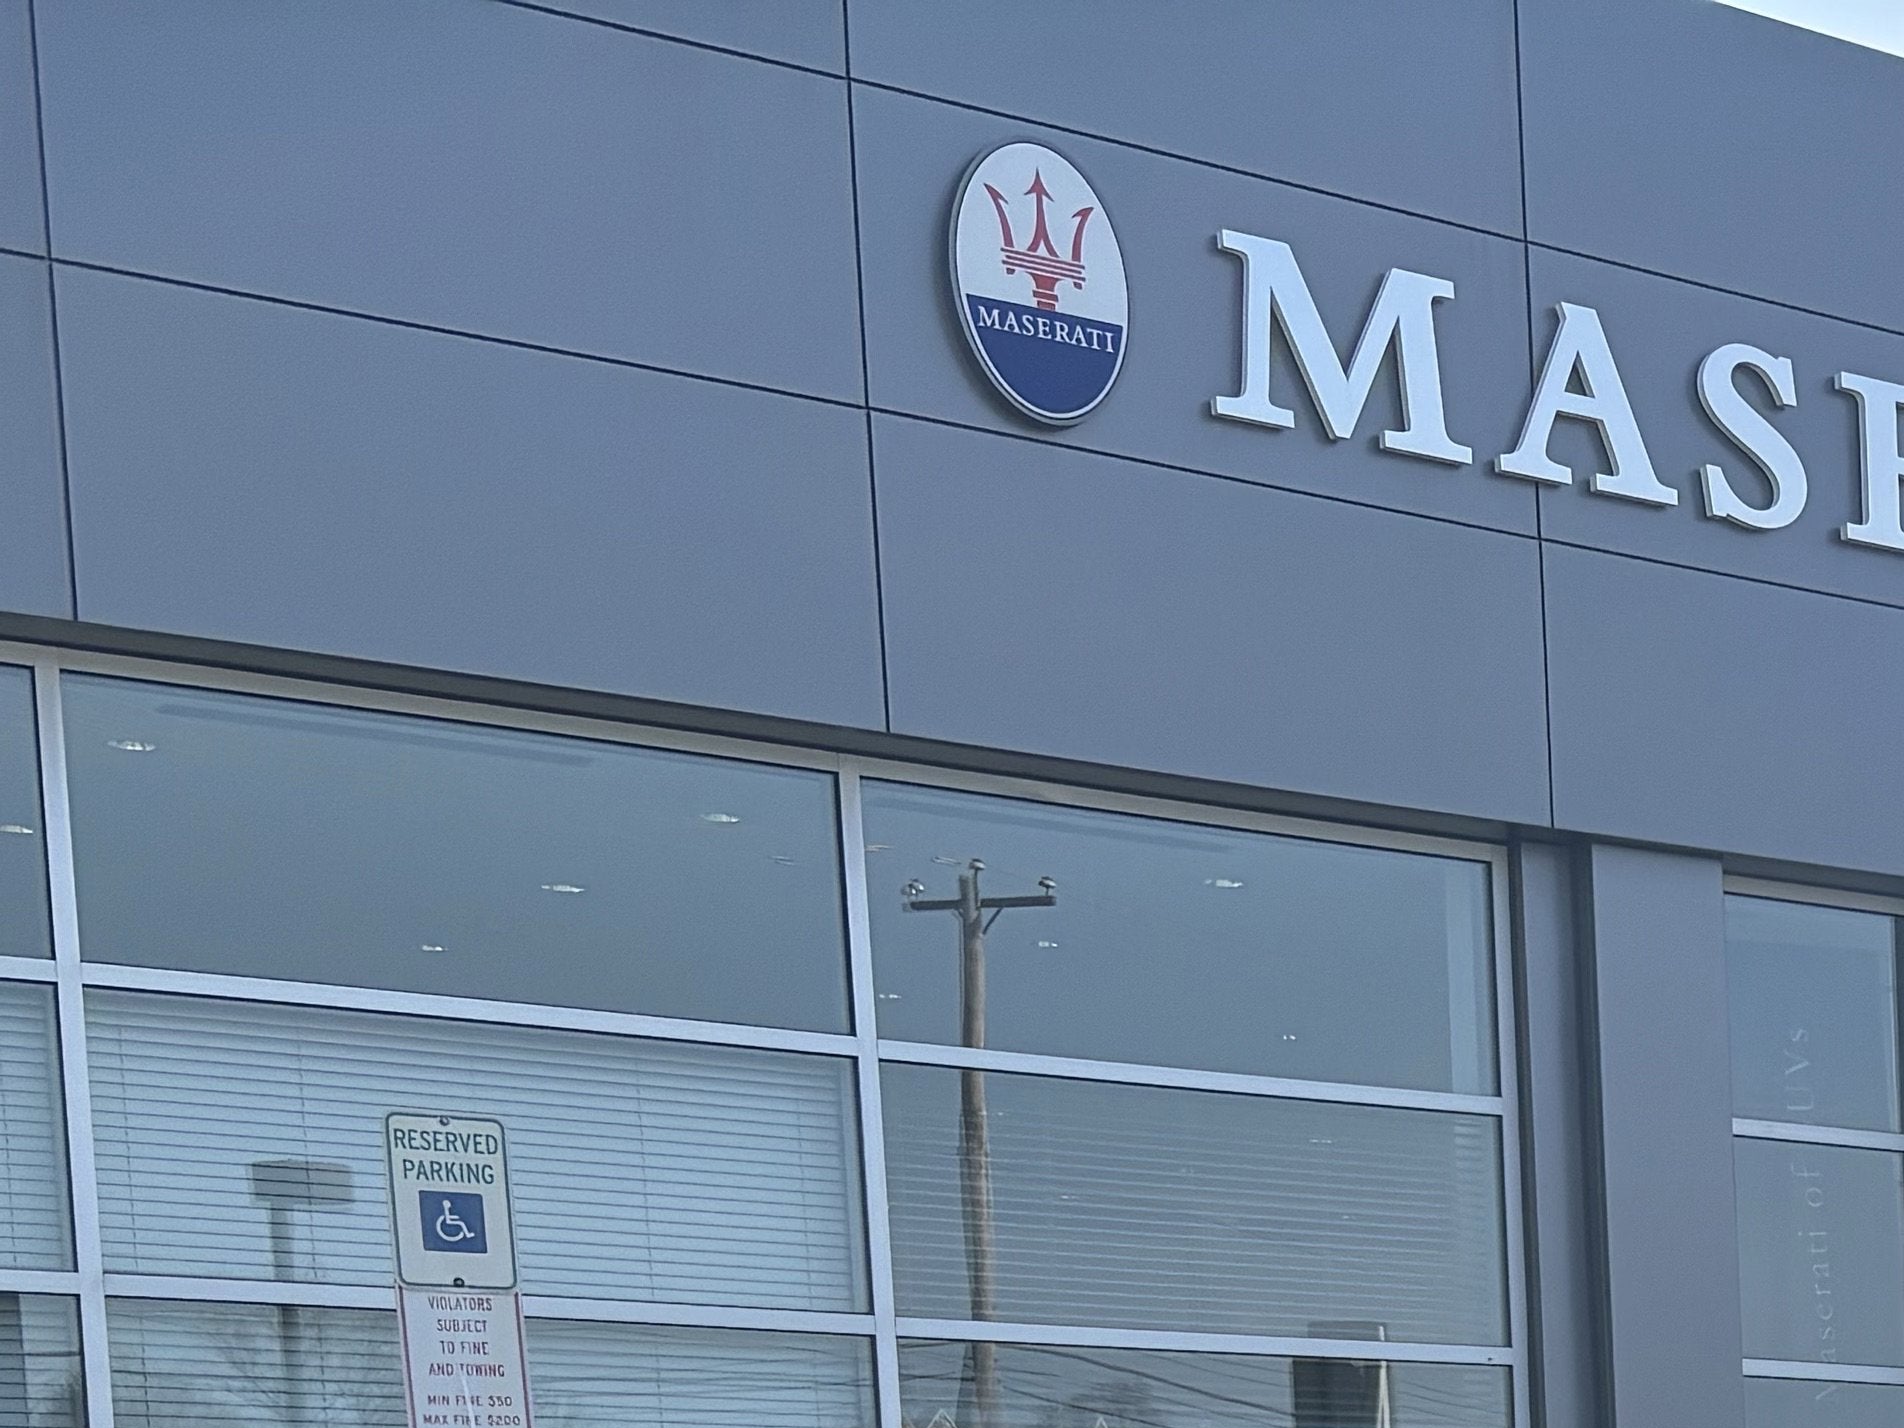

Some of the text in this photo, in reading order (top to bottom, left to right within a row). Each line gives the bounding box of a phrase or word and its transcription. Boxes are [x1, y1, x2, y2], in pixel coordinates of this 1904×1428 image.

[977, 305, 1115, 353] MASERATI
[393, 1128, 498, 1155] RESERVED
[402, 1159, 496, 1184] PARKING
[428, 1296, 493, 1312] VIOLATORS
[436, 1319, 488, 1333] SUBJECT
[440, 1340, 489, 1356] TO FINE
[428, 1362, 505, 1378] AND TOWING
[427, 1394, 450, 1407] MIN
[423, 1413, 449, 1425] MAX
